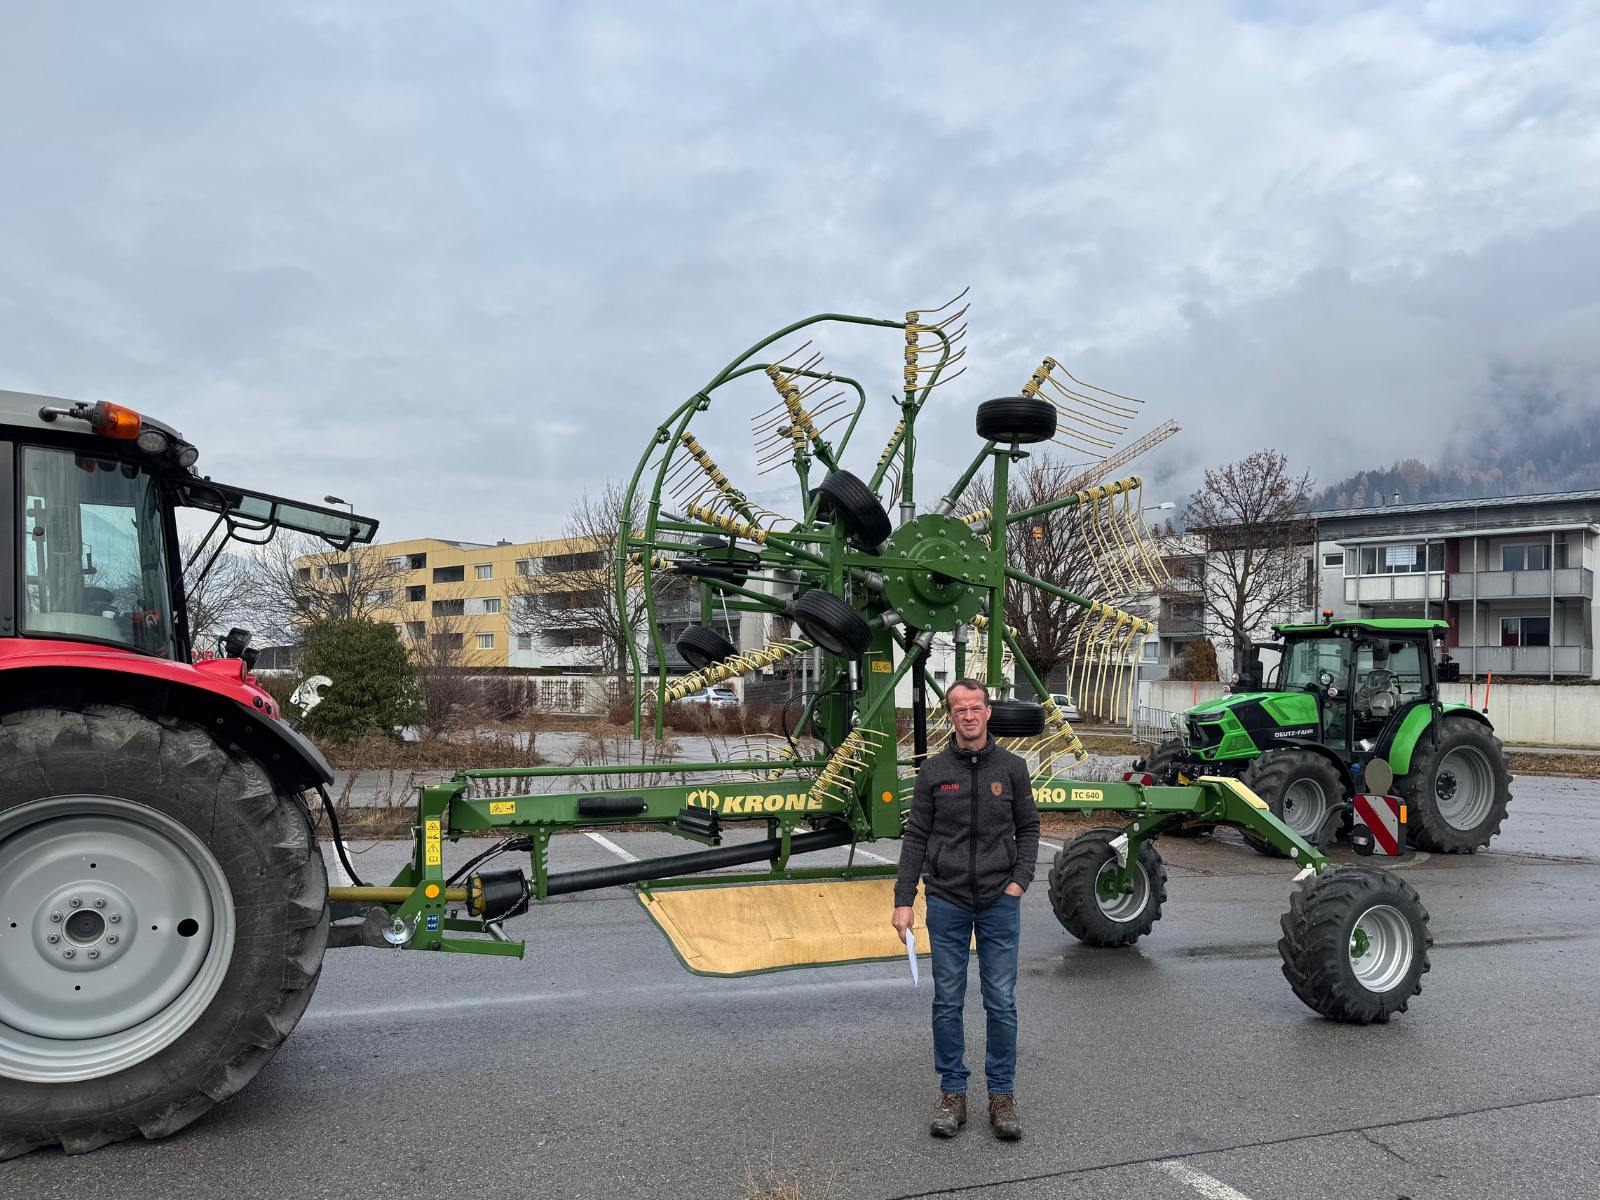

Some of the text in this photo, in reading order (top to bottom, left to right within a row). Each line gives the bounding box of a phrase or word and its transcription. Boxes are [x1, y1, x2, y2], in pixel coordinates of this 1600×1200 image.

[1274, 729, 1314, 738] DEUTZ-FAHR
[1073, 791, 1100, 799] TC 640
[722, 793, 823, 814] KRONE
